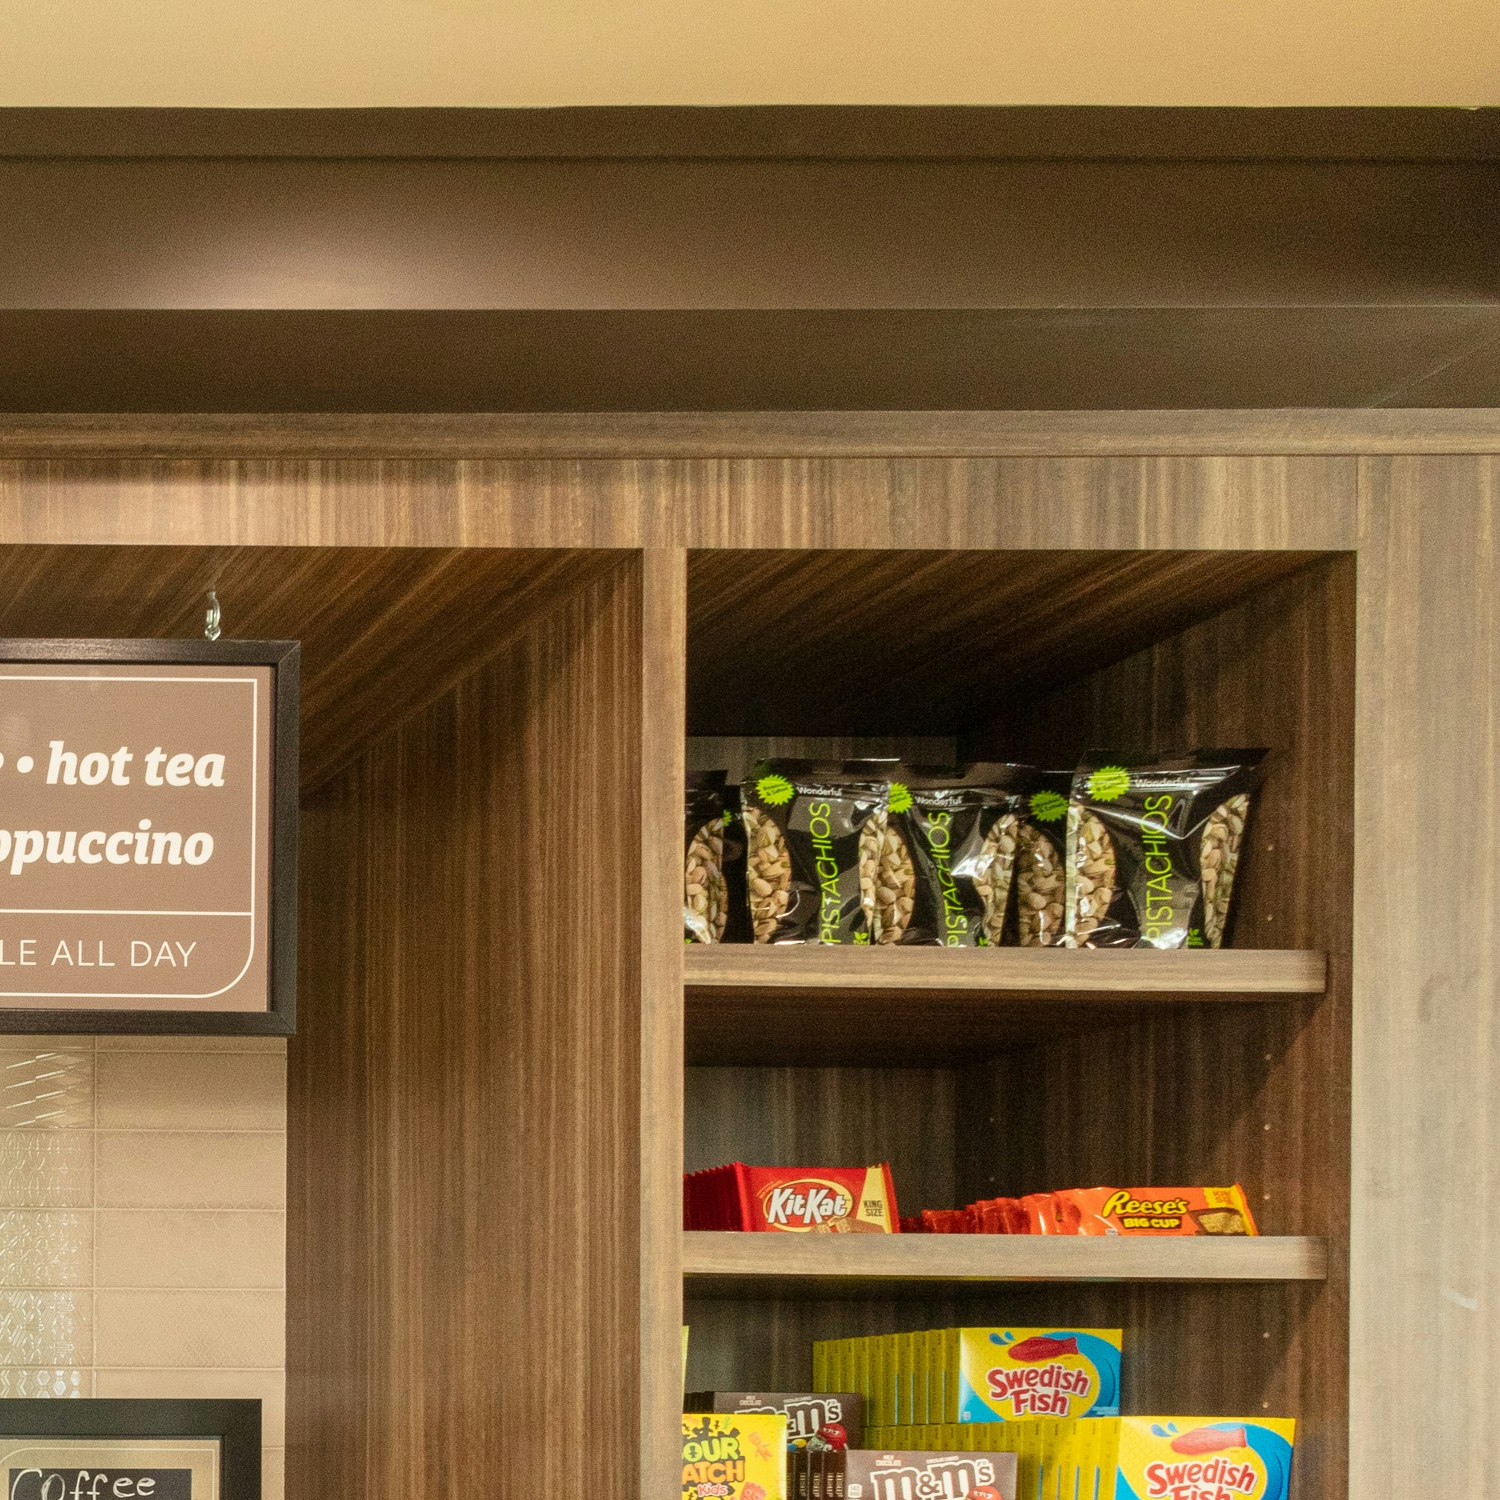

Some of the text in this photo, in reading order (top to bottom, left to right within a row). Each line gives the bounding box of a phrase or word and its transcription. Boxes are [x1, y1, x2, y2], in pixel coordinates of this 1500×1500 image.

[47, 742, 129, 785] hot
[145, 749, 224, 788] tea
[797, 786, 842, 796] Wonderful
[809, 802, 840, 944] PISTACHIOS
[928, 812, 969, 947] PISTACHIOS
[1141, 795, 1173, 941] PISTACHIOS
[52, 939, 114, 967] ALL
[129, 940, 196, 969] DAY
[864, 1200, 882, 1208] KING
[1103, 1191, 1188, 1217] Reese's
[1123, 1218, 1180, 1228] BIG CUP
[987, 1364, 1090, 1398] Swedish
[1011, 1389, 1068, 1415] Fish
[683, 1435, 739, 1460] OUR
[683, 1459, 745, 1483] ATCH
[1145, 1460, 1256, 1494] Swedish
[698, 1483, 728, 1496] Kids
